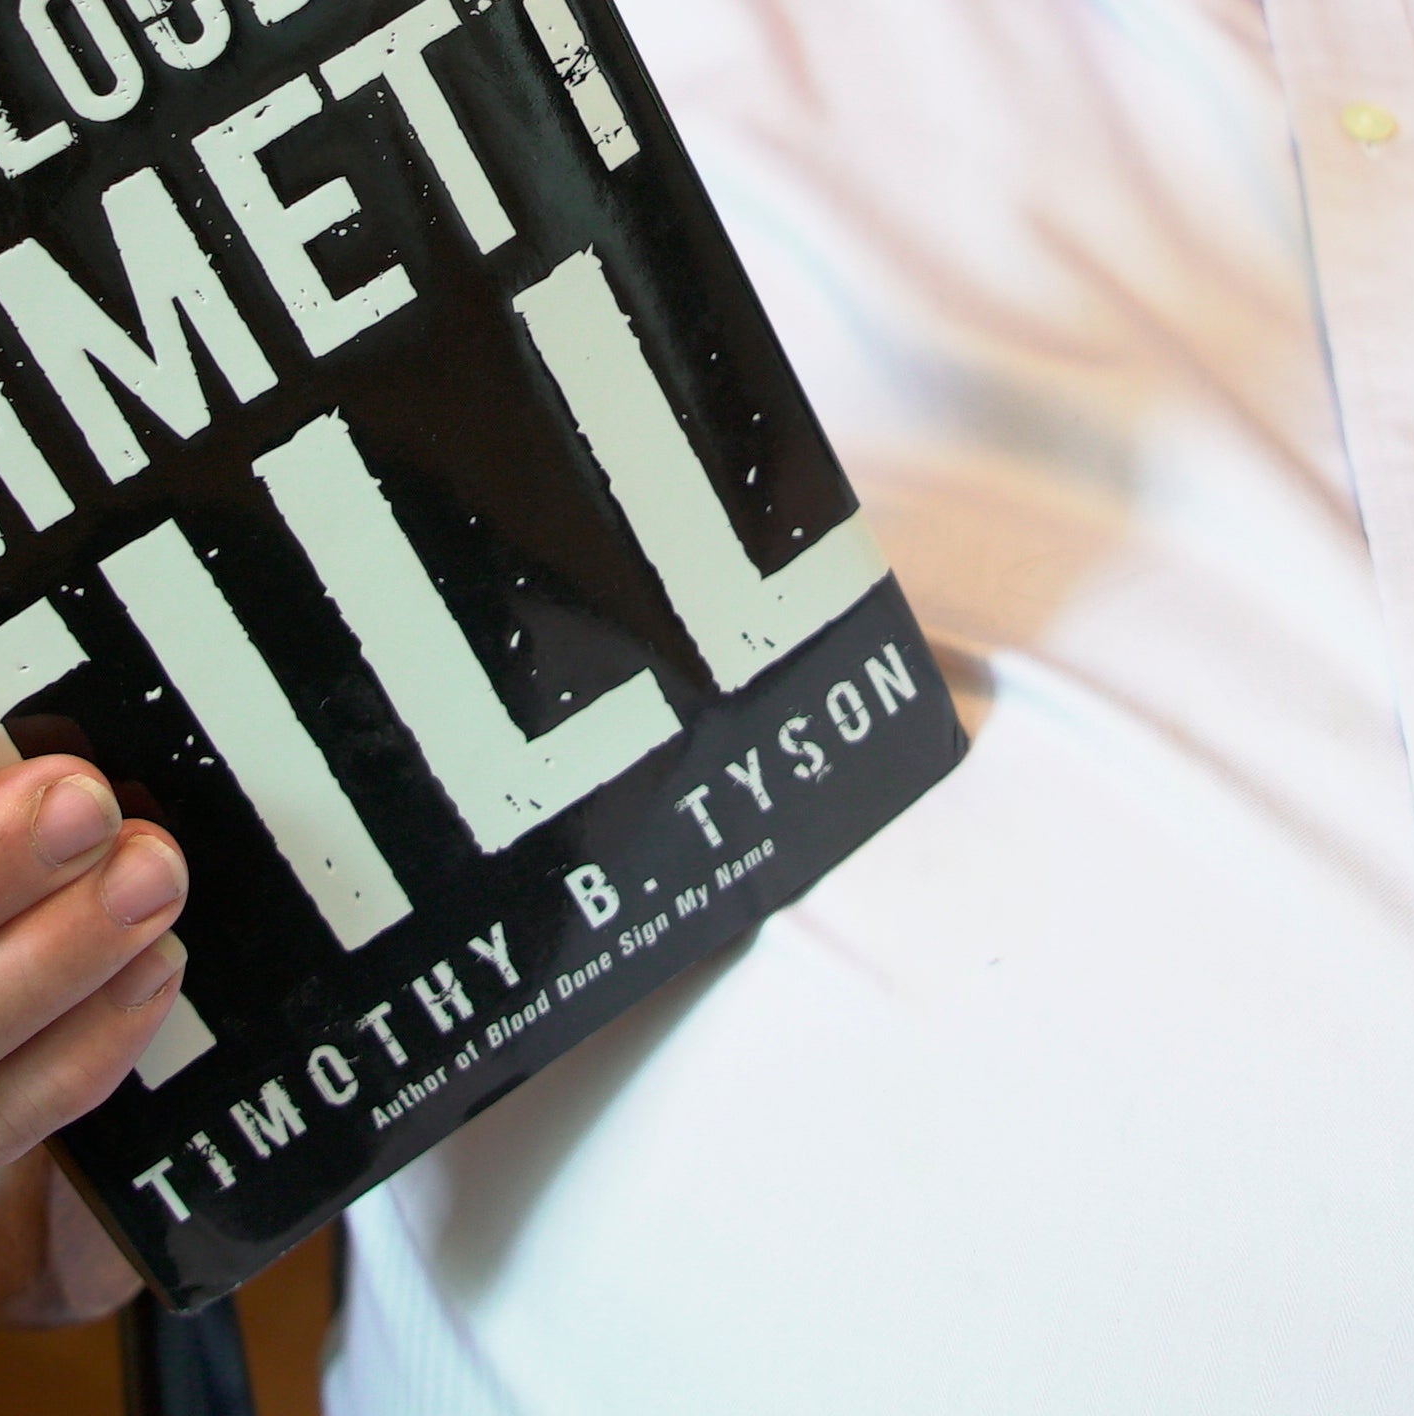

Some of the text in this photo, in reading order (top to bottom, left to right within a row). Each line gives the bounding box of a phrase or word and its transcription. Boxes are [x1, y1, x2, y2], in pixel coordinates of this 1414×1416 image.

[133, 642, 917, 1221] TIMOTHY B. TYSON
[373, 838, 774, 1128] Author of Blood Done Sign My Name
